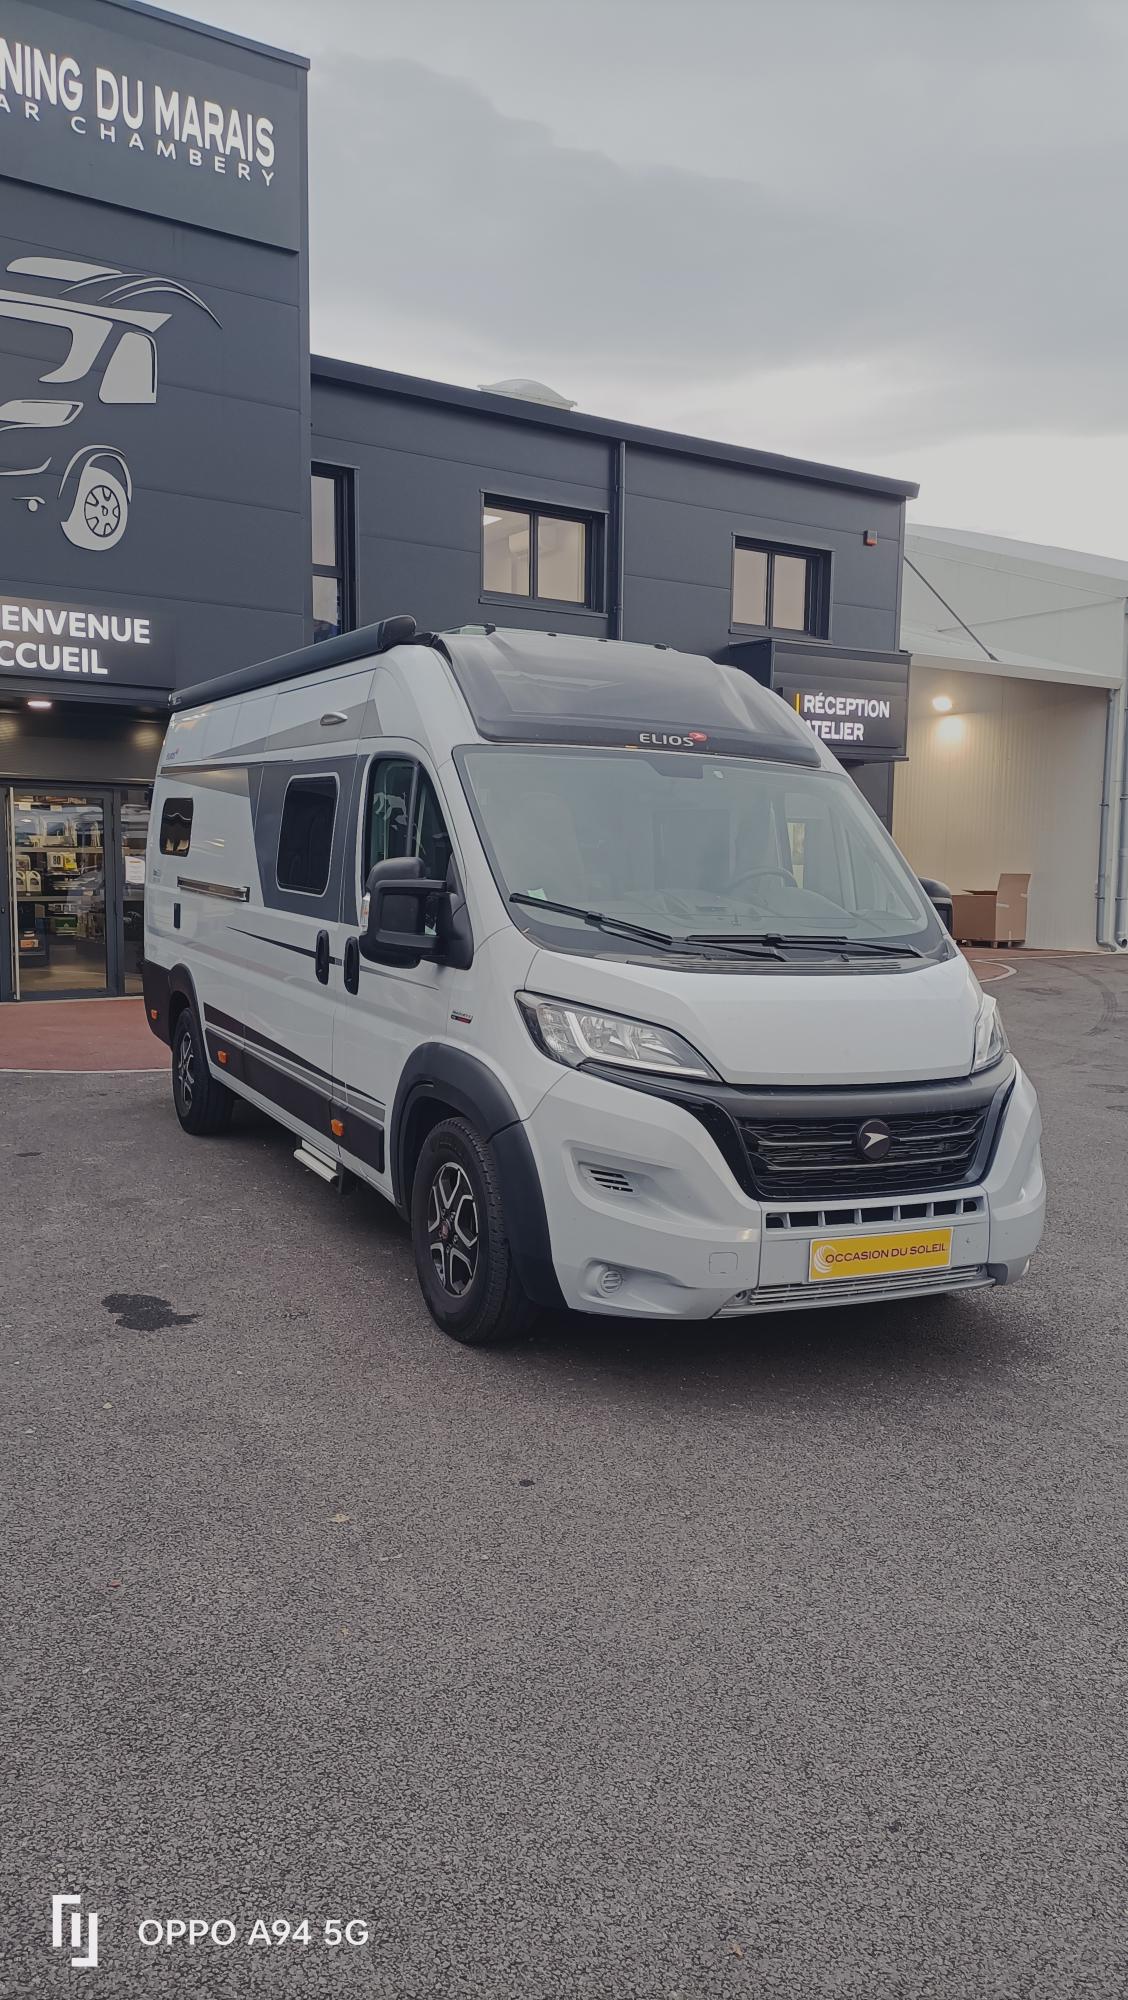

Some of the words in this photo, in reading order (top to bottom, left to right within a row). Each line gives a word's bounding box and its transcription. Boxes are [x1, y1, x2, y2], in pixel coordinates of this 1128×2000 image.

[0, 37, 83, 111] NING
[96, 67, 144, 129] DU
[155, 85, 275, 167] MARAIS
[70, 116, 274, 186] CHAMBERY
[2, 604, 150, 644] ENVENUE
[803, 692, 890, 718] RÉCEPTION
[640, 733, 694, 747] ELIOS
[825, 1248, 889, 1264] OCCASION
[891, 1246, 908, 1257] DU
[909, 1243, 947, 1255] SOLEIL
